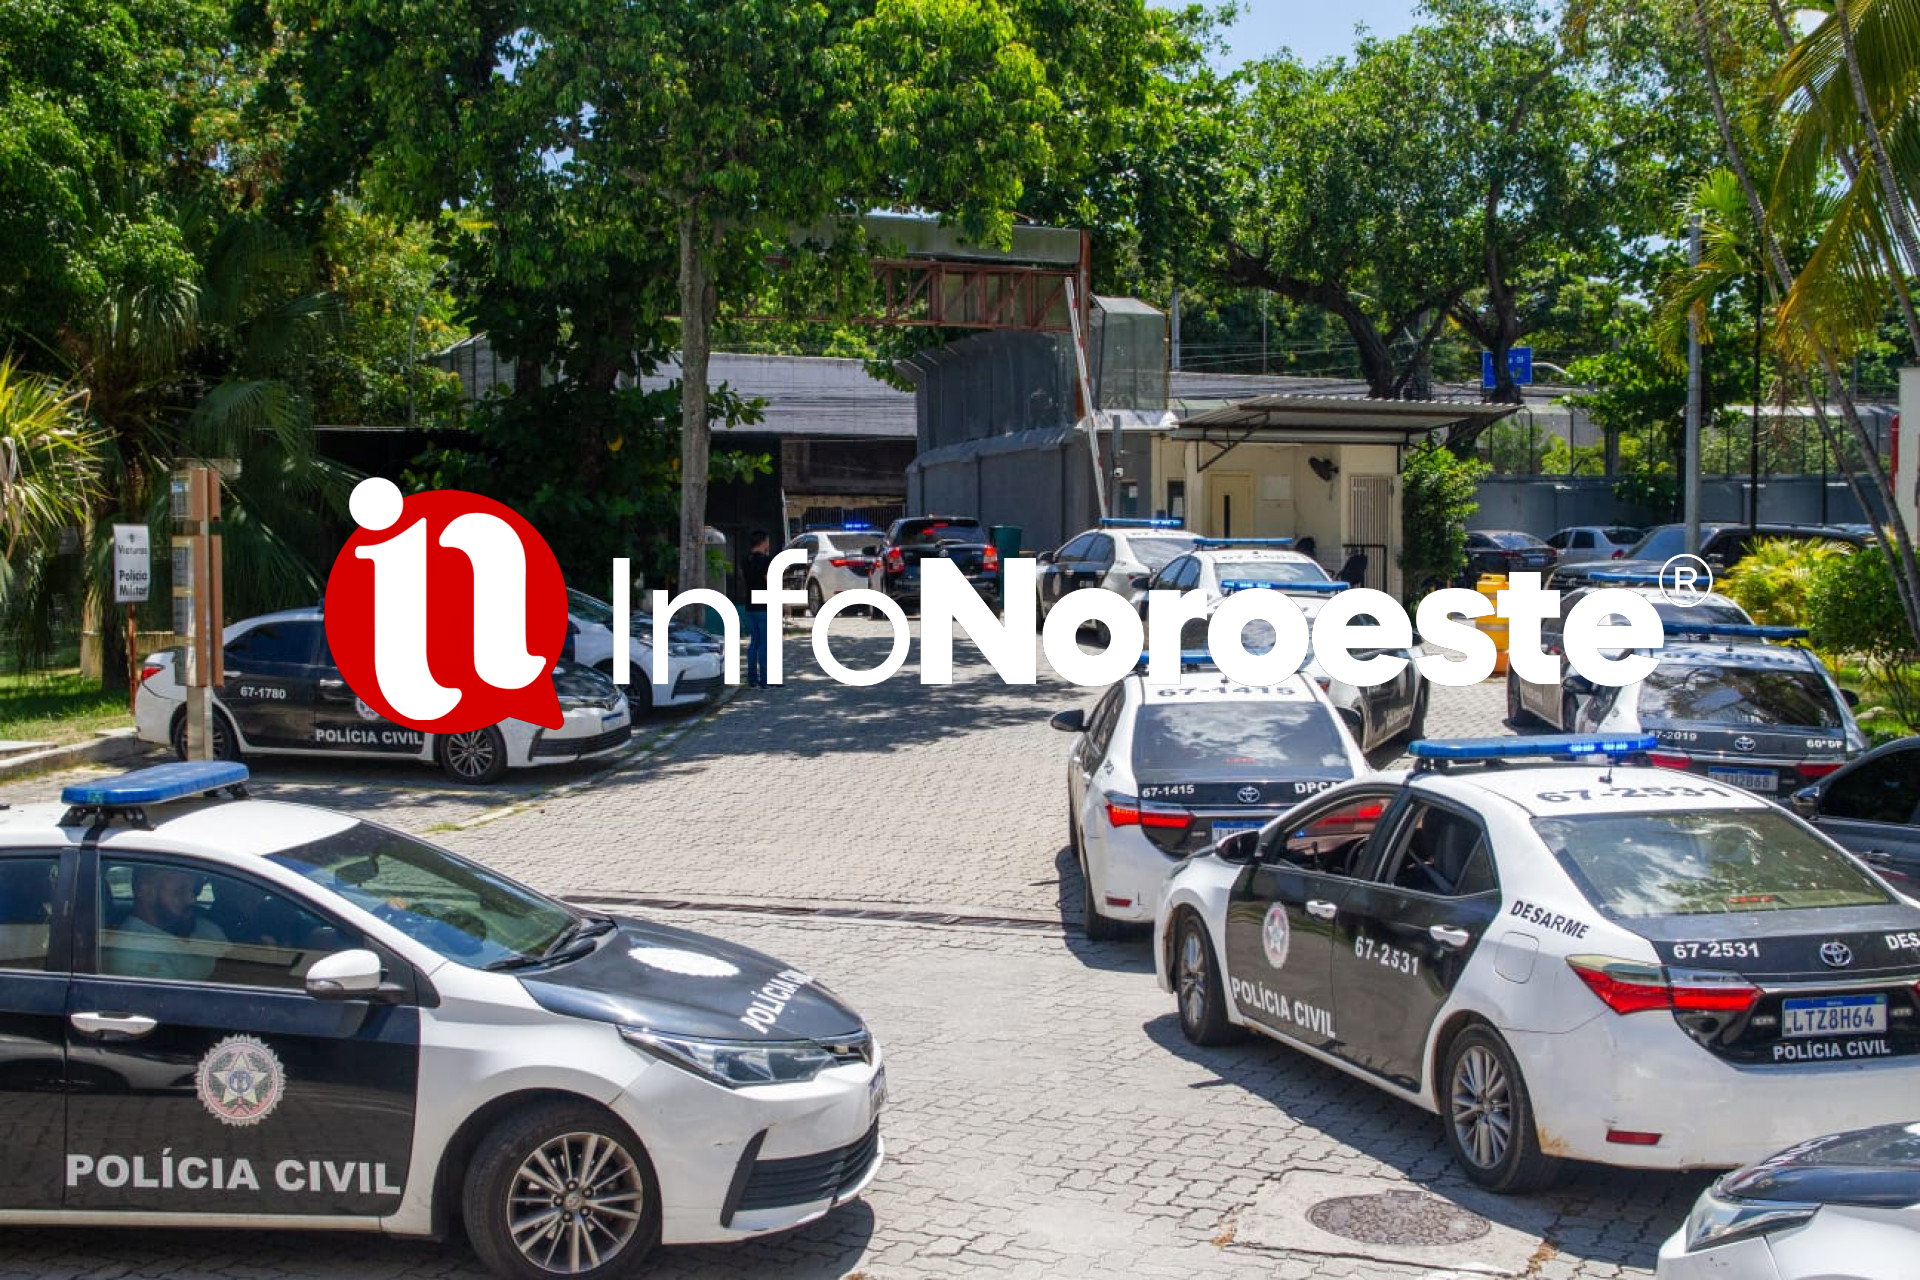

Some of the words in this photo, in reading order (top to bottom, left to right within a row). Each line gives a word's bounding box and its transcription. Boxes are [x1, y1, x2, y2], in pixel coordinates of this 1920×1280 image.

[240, 686, 286, 700] 67-1780
[316, 728, 378, 744] POLÍCIA
[382, 731, 423, 745] CIVIL
[1141, 784, 1195, 798] 67-1415
[1536, 786, 1731, 803] 67-2531
[1509, 899, 1590, 940] DESARME
[1672, 942, 1761, 959] 67-2531
[1884, 931, 1920, 950] DES
[1355, 935, 1420, 977] 67-2531
[739, 977, 801, 1036] POLÍCIA
[1230, 976, 1292, 1022] POLÍCIA
[1294, 1000, 1336, 1038] CIVIL
[1793, 1006, 1875, 1032] LTZ8H64
[1772, 1040, 1843, 1061] POLÍCIA
[1846, 1039, 1892, 1056] CIVIL
[65, 1147, 260, 1192] POLÍCIA
[274, 1158, 402, 1195] CIVIL
